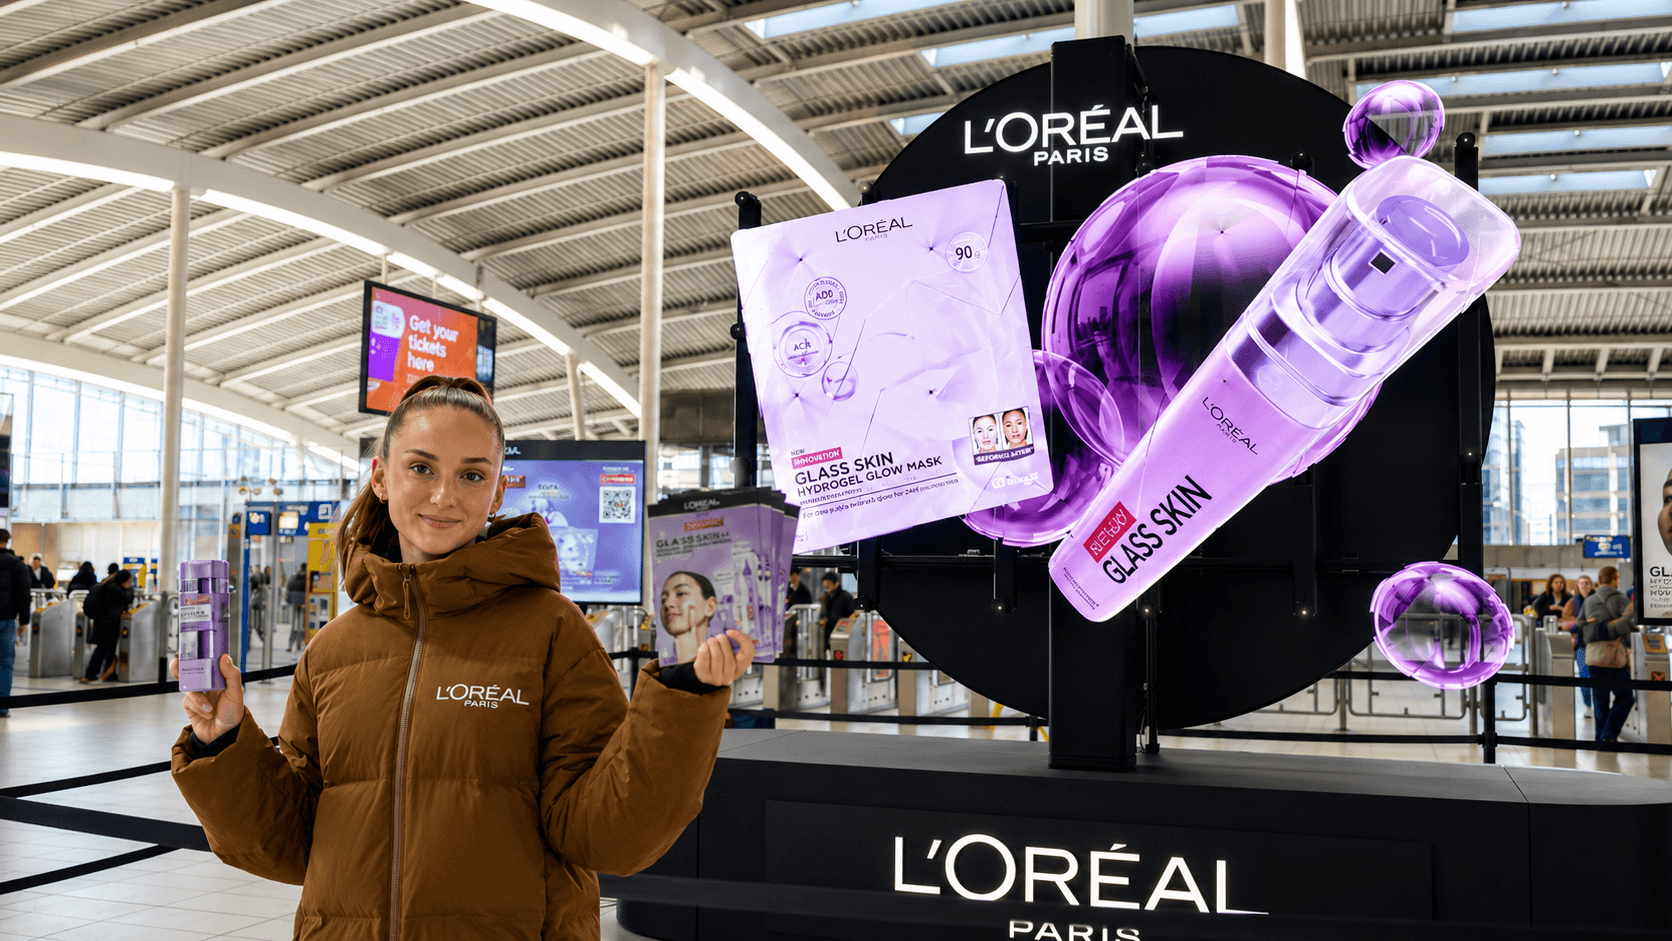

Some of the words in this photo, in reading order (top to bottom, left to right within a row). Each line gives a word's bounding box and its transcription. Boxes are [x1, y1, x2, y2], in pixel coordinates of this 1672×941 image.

[964, 104, 1184, 154] L'ORÉAL
[1033, 146, 1109, 166] PARIS
[835, 217, 913, 243] L'ORÉAL
[955, 245, 973, 260] 90
[409, 314, 431, 335] Get
[433, 324, 459, 342] your
[408, 334, 447, 358] tickets
[407, 351, 434, 372] here
[1202, 396, 1258, 455] L'ORÉAL
[795, 462, 850, 485] GLASS
[854, 451, 894, 472] SKIN
[797, 474, 864, 497] HYDROGEL
[866, 464, 903, 481] GLOW
[907, 455, 942, 472] MASK
[1102, 523, 1163, 584] GLASS
[1150, 474, 1213, 536] SKIN
[1649, 566, 1672, 577] GL
[436, 683, 530, 705] L'ORÉAL
[464, 699, 499, 709] PARIS
[894, 833, 1269, 915] L'ORÉAL
[1008, 919, 1141, 941] PARIS
